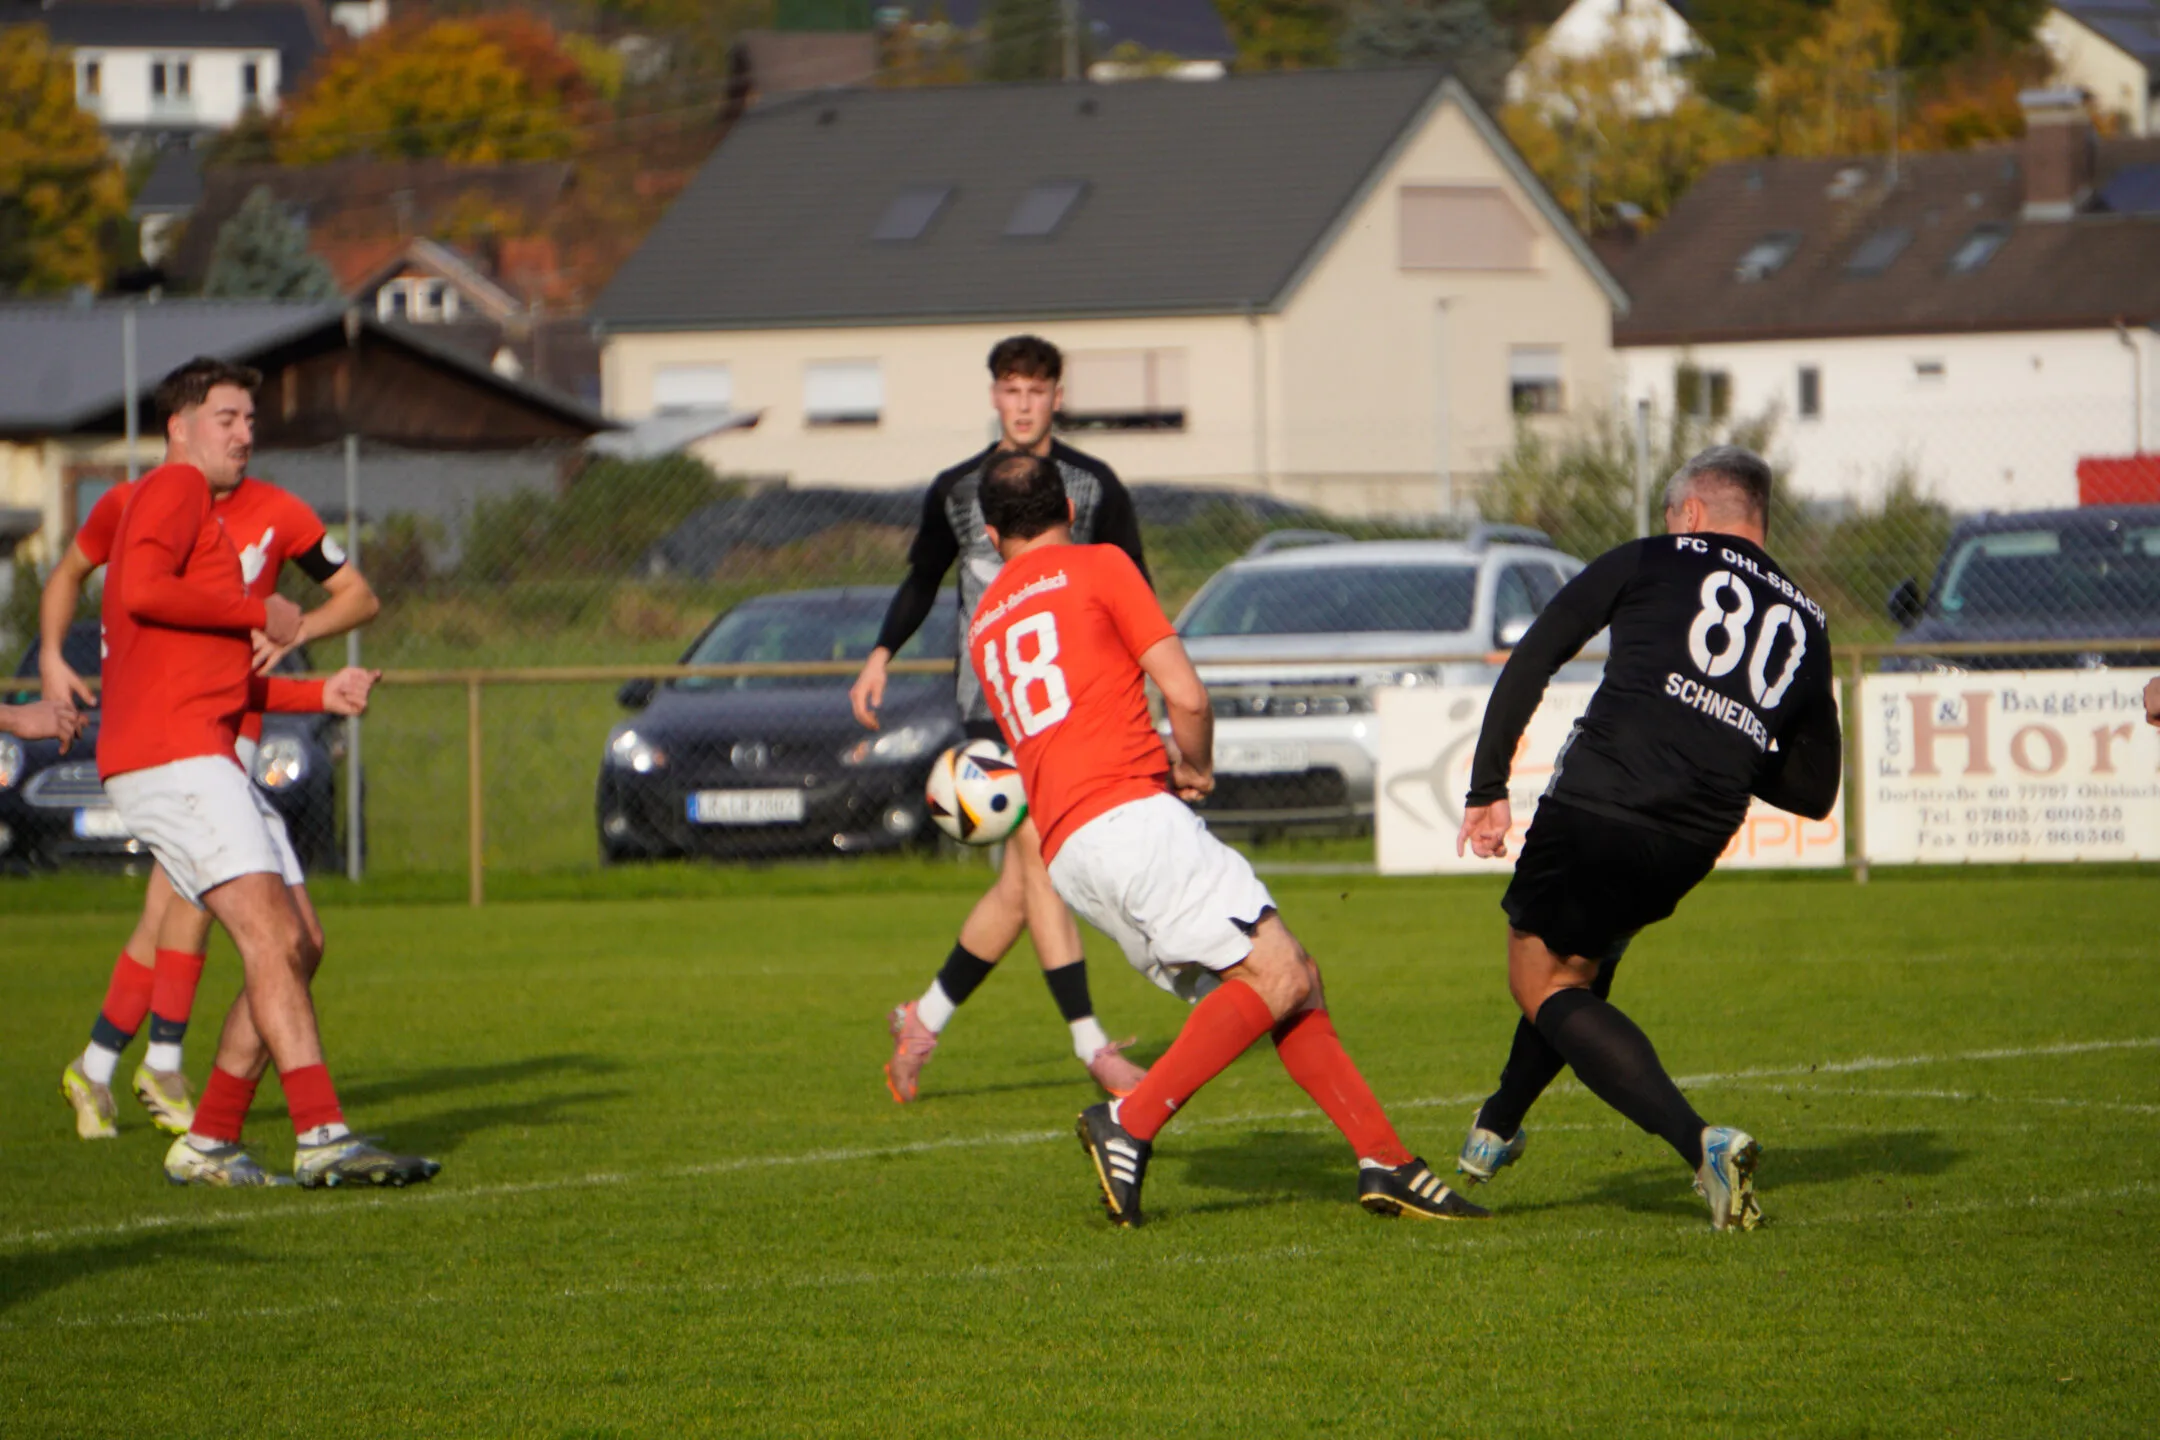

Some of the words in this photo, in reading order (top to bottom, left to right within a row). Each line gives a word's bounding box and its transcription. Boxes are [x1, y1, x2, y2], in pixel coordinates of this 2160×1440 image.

[1676, 536, 1709, 554] FC
[1720, 548, 1826, 630] OHLSBACH
[984, 611, 1073, 746] 18
[1688, 570, 1808, 710] 80
[1664, 672, 1768, 753] SCHNEIDER
[1905, 690, 2160, 777] Hor
